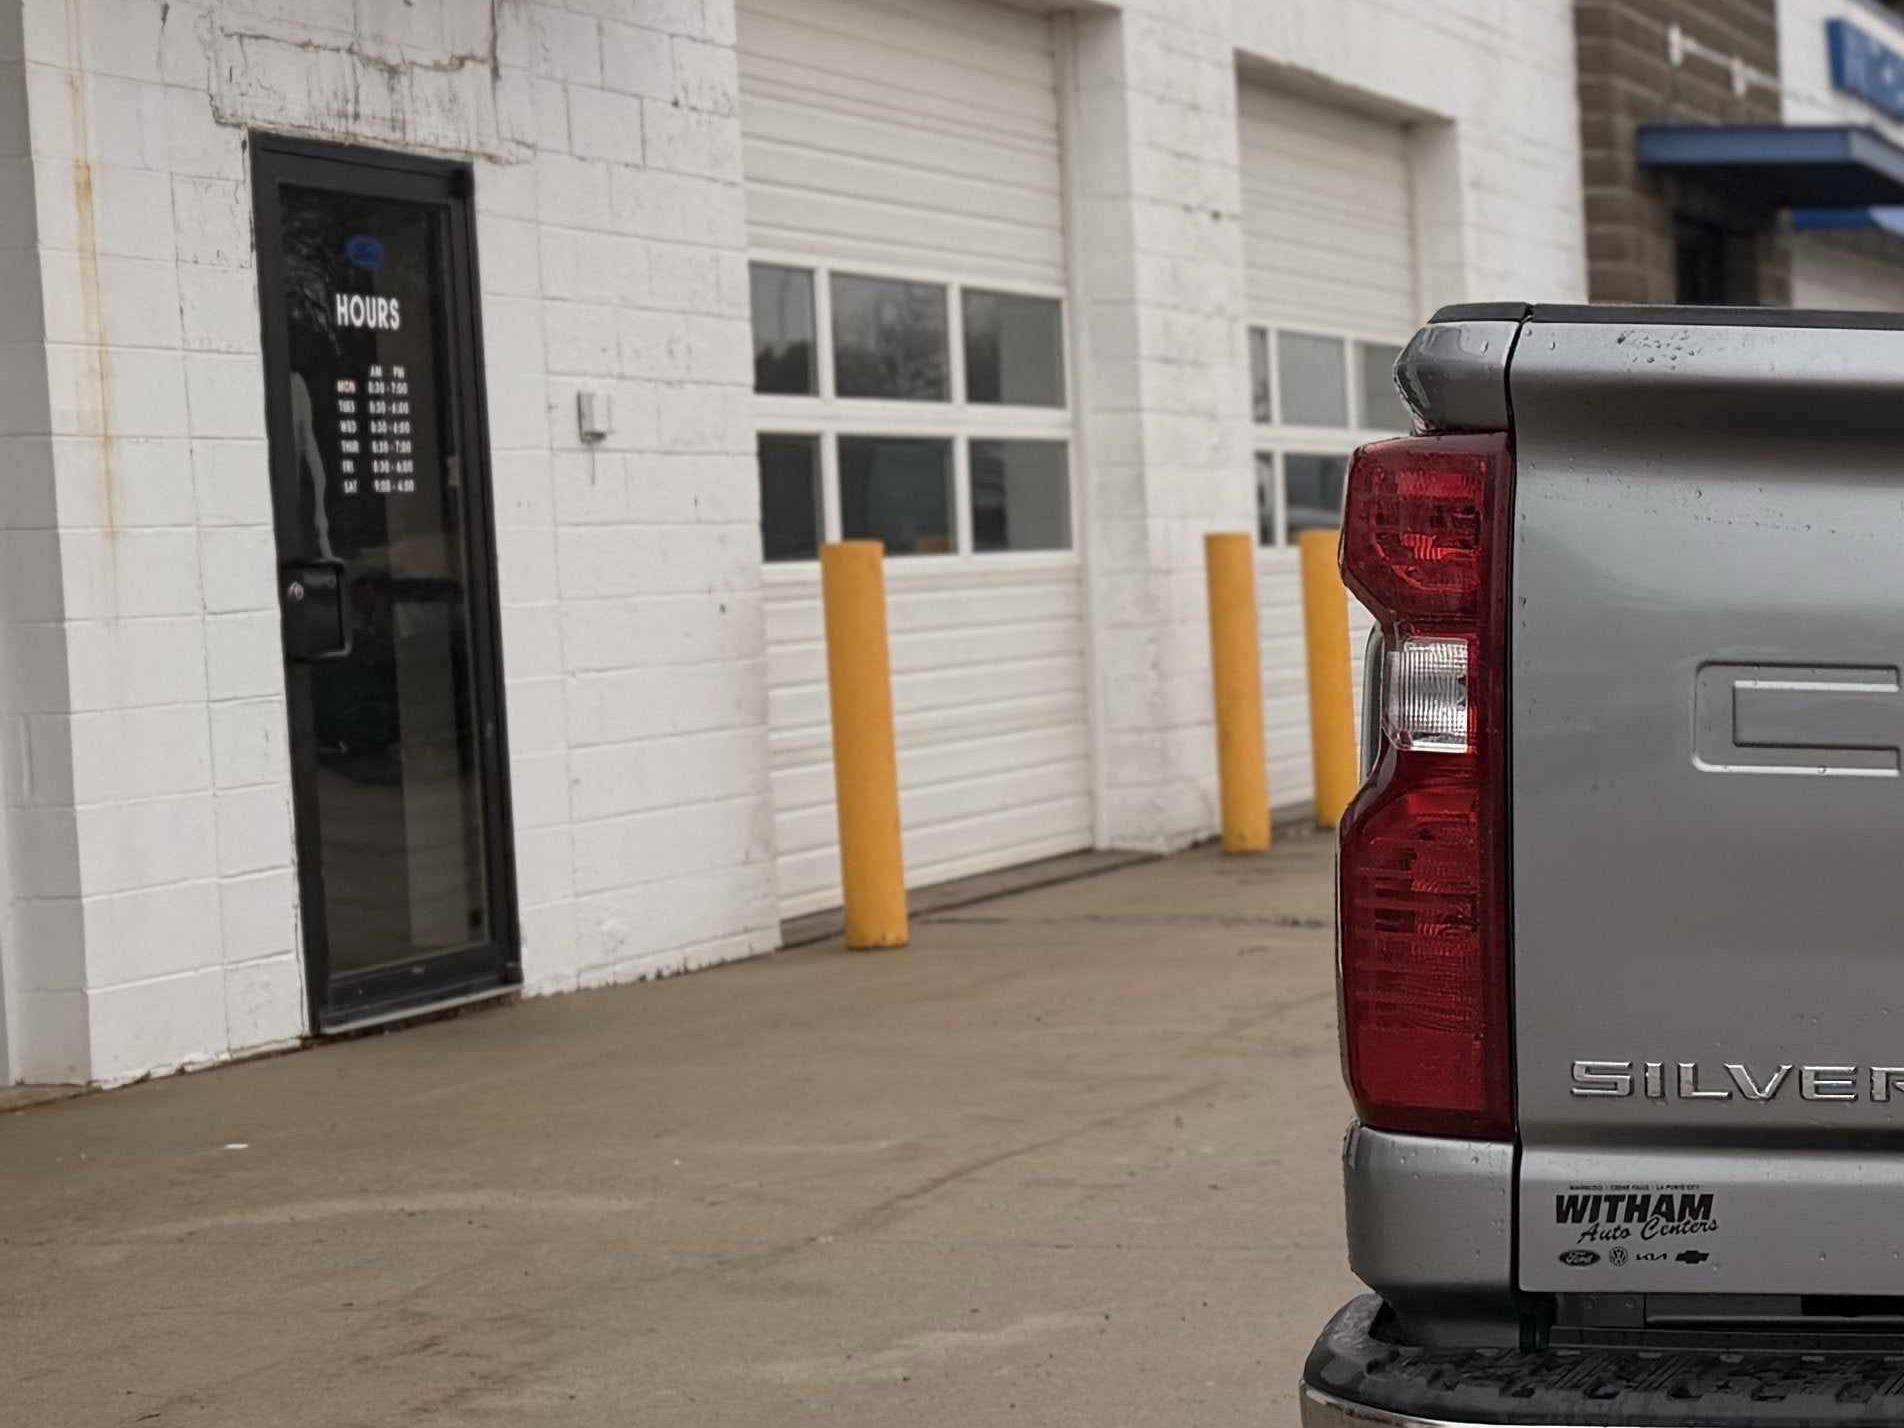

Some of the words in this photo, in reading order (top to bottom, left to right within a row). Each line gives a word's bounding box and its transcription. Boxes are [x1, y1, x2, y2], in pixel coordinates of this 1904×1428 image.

[335, 293, 400, 330] HOURS
[1556, 1193, 1715, 1224] WITHAM
[1576, 1222, 1632, 1244] Auto
[1640, 1216, 1720, 1241] Centers
